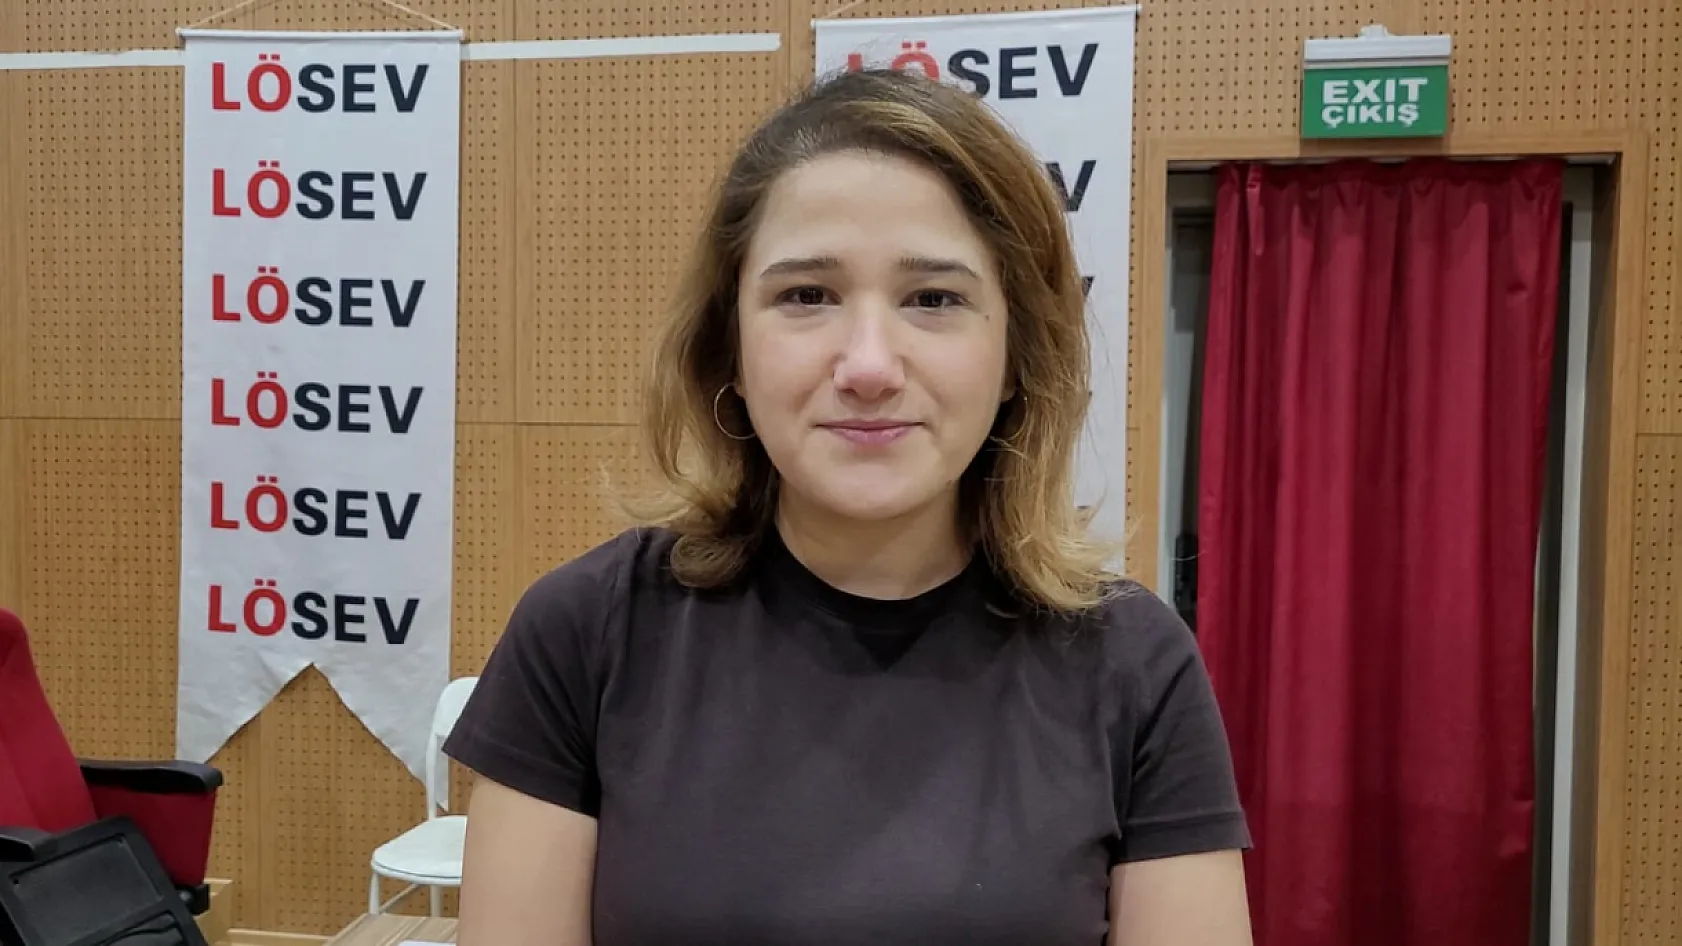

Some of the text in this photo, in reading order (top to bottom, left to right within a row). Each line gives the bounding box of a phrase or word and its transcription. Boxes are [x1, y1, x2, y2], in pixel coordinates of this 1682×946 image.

[212, 54, 429, 113] LÖSEV
[1322, 77, 1428, 104] EXIT
[1321, 103, 1420, 128] ÇIKIŞ
[212, 160, 427, 220] LÖSEV
[211, 266, 426, 328] LÖSEV
[210, 371, 424, 434] LÖSEV
[210, 475, 422, 540] LÖSEV
[207, 578, 420, 645] LÖSEV
